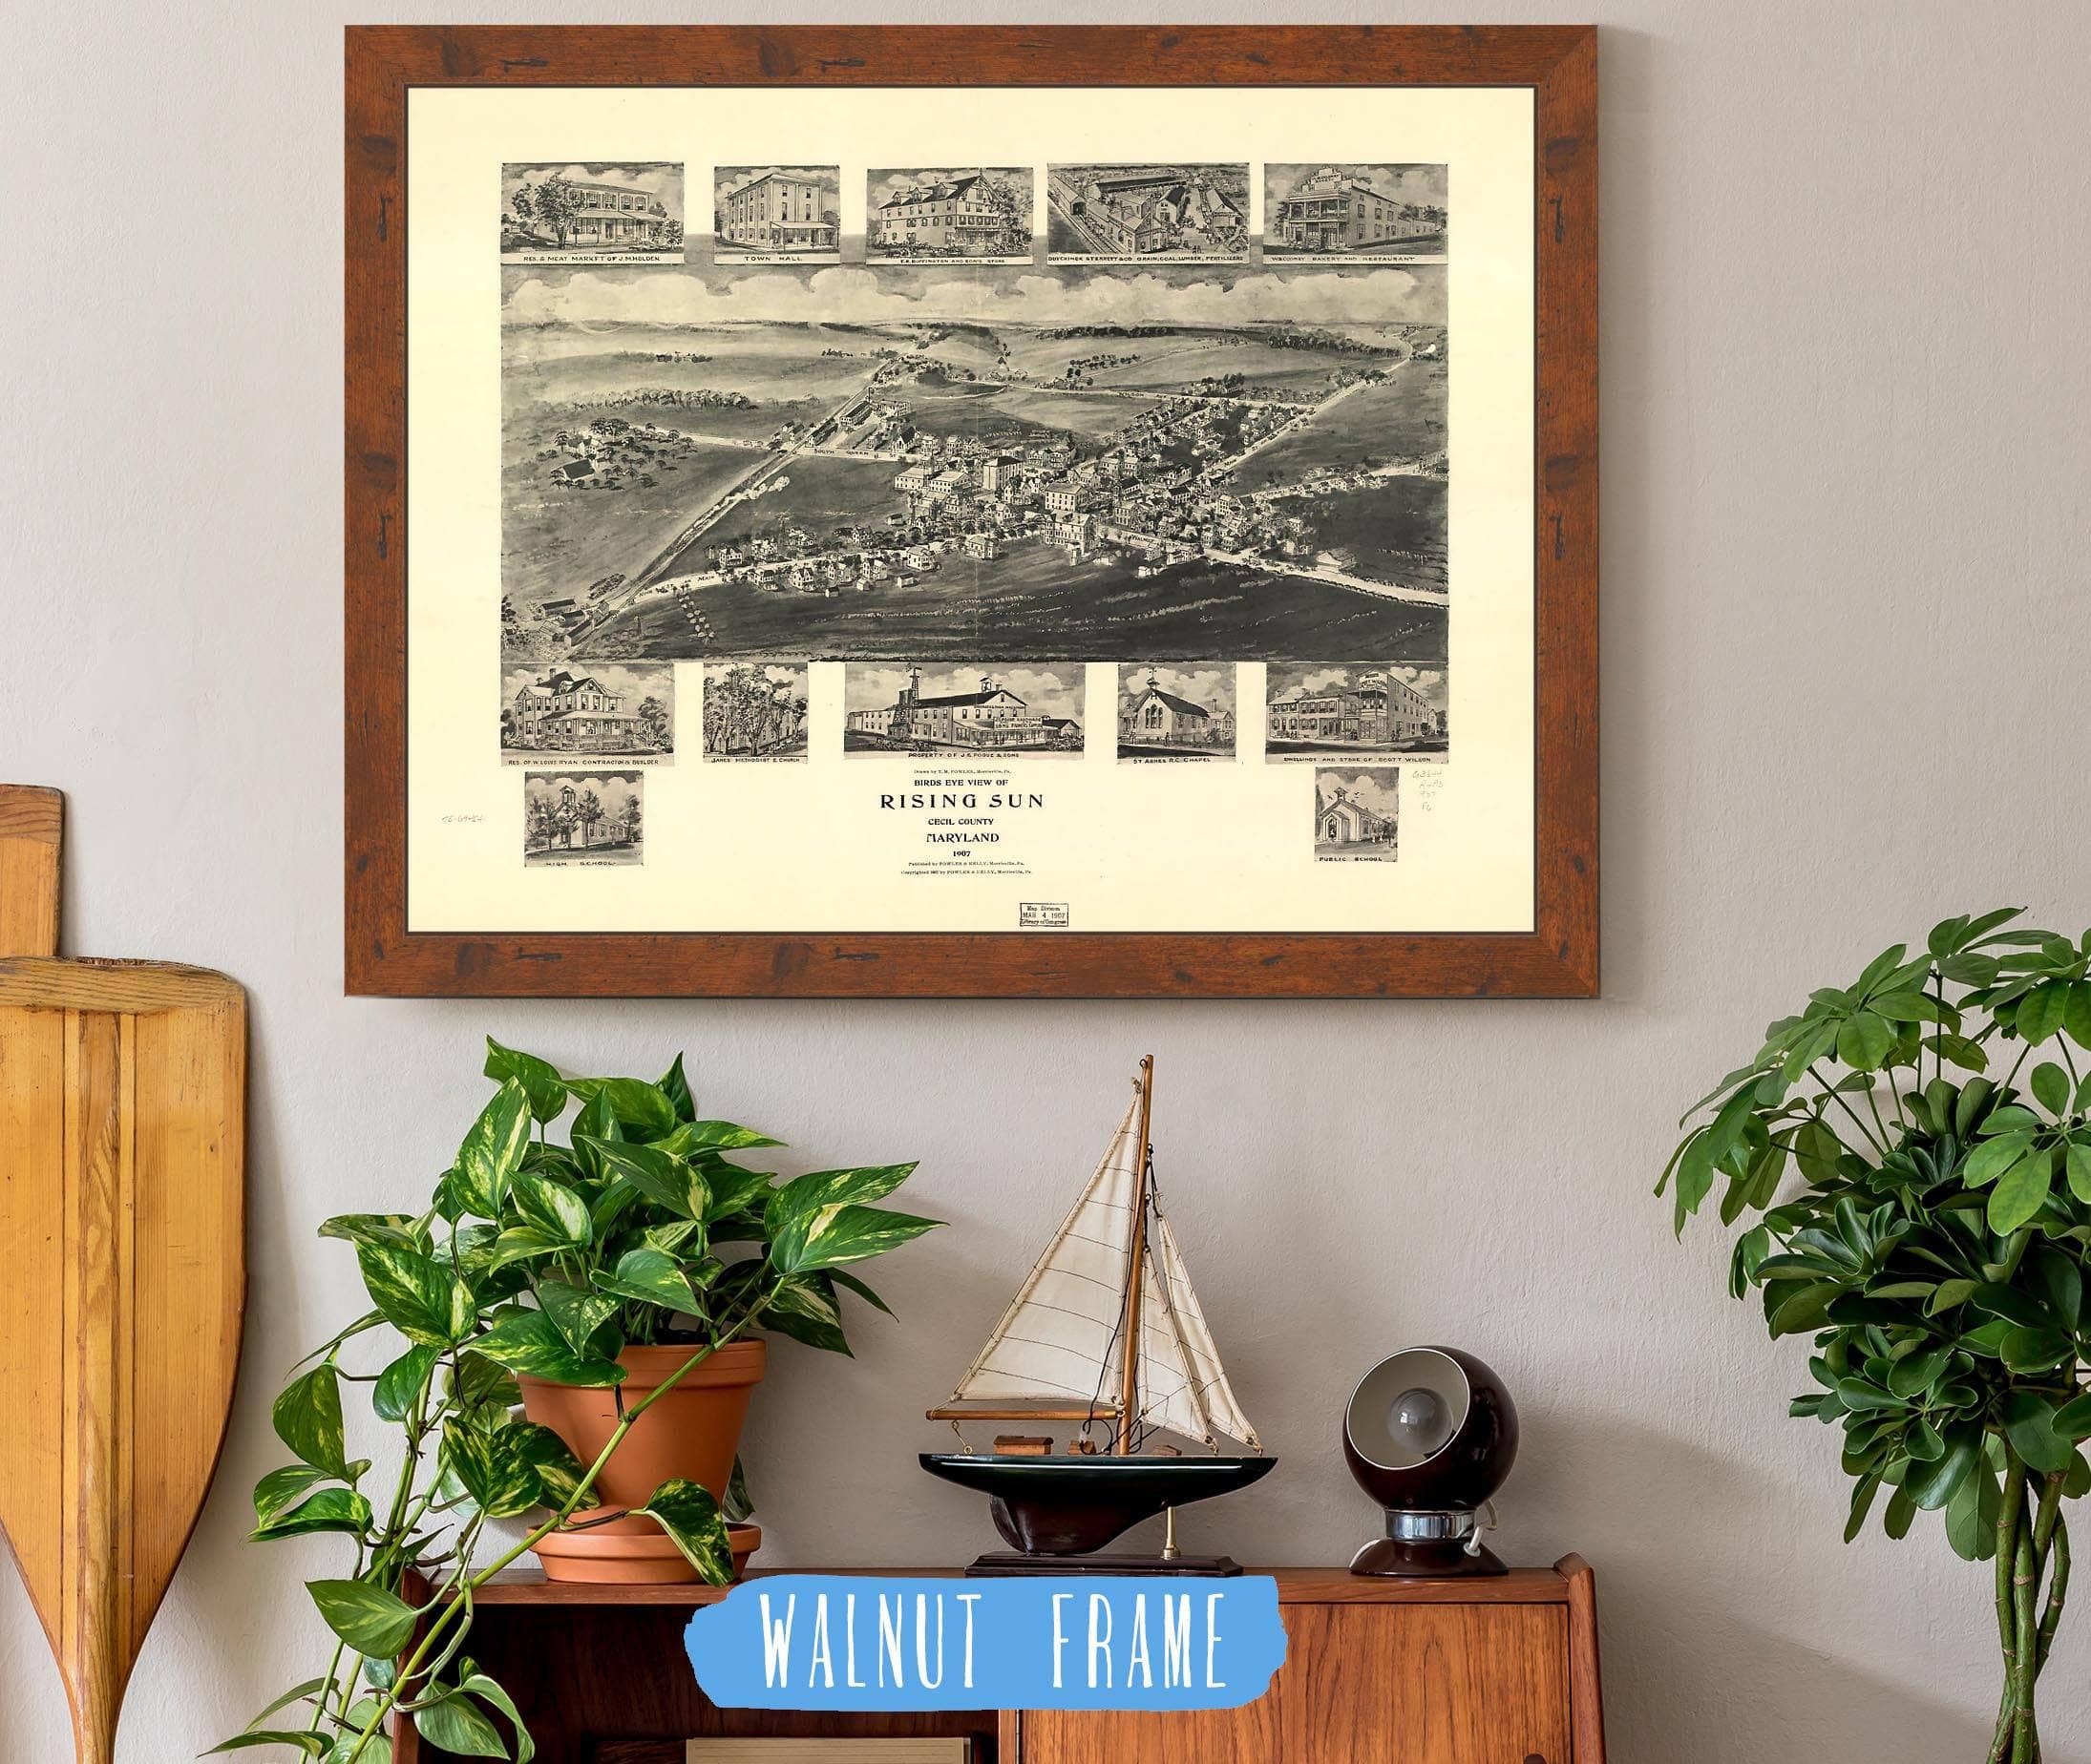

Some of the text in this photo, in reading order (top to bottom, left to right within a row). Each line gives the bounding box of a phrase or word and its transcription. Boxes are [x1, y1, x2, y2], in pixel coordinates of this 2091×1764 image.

[880, 794, 1043, 809] RISING SUN
[926, 833, 1000, 843] MARYLAND
